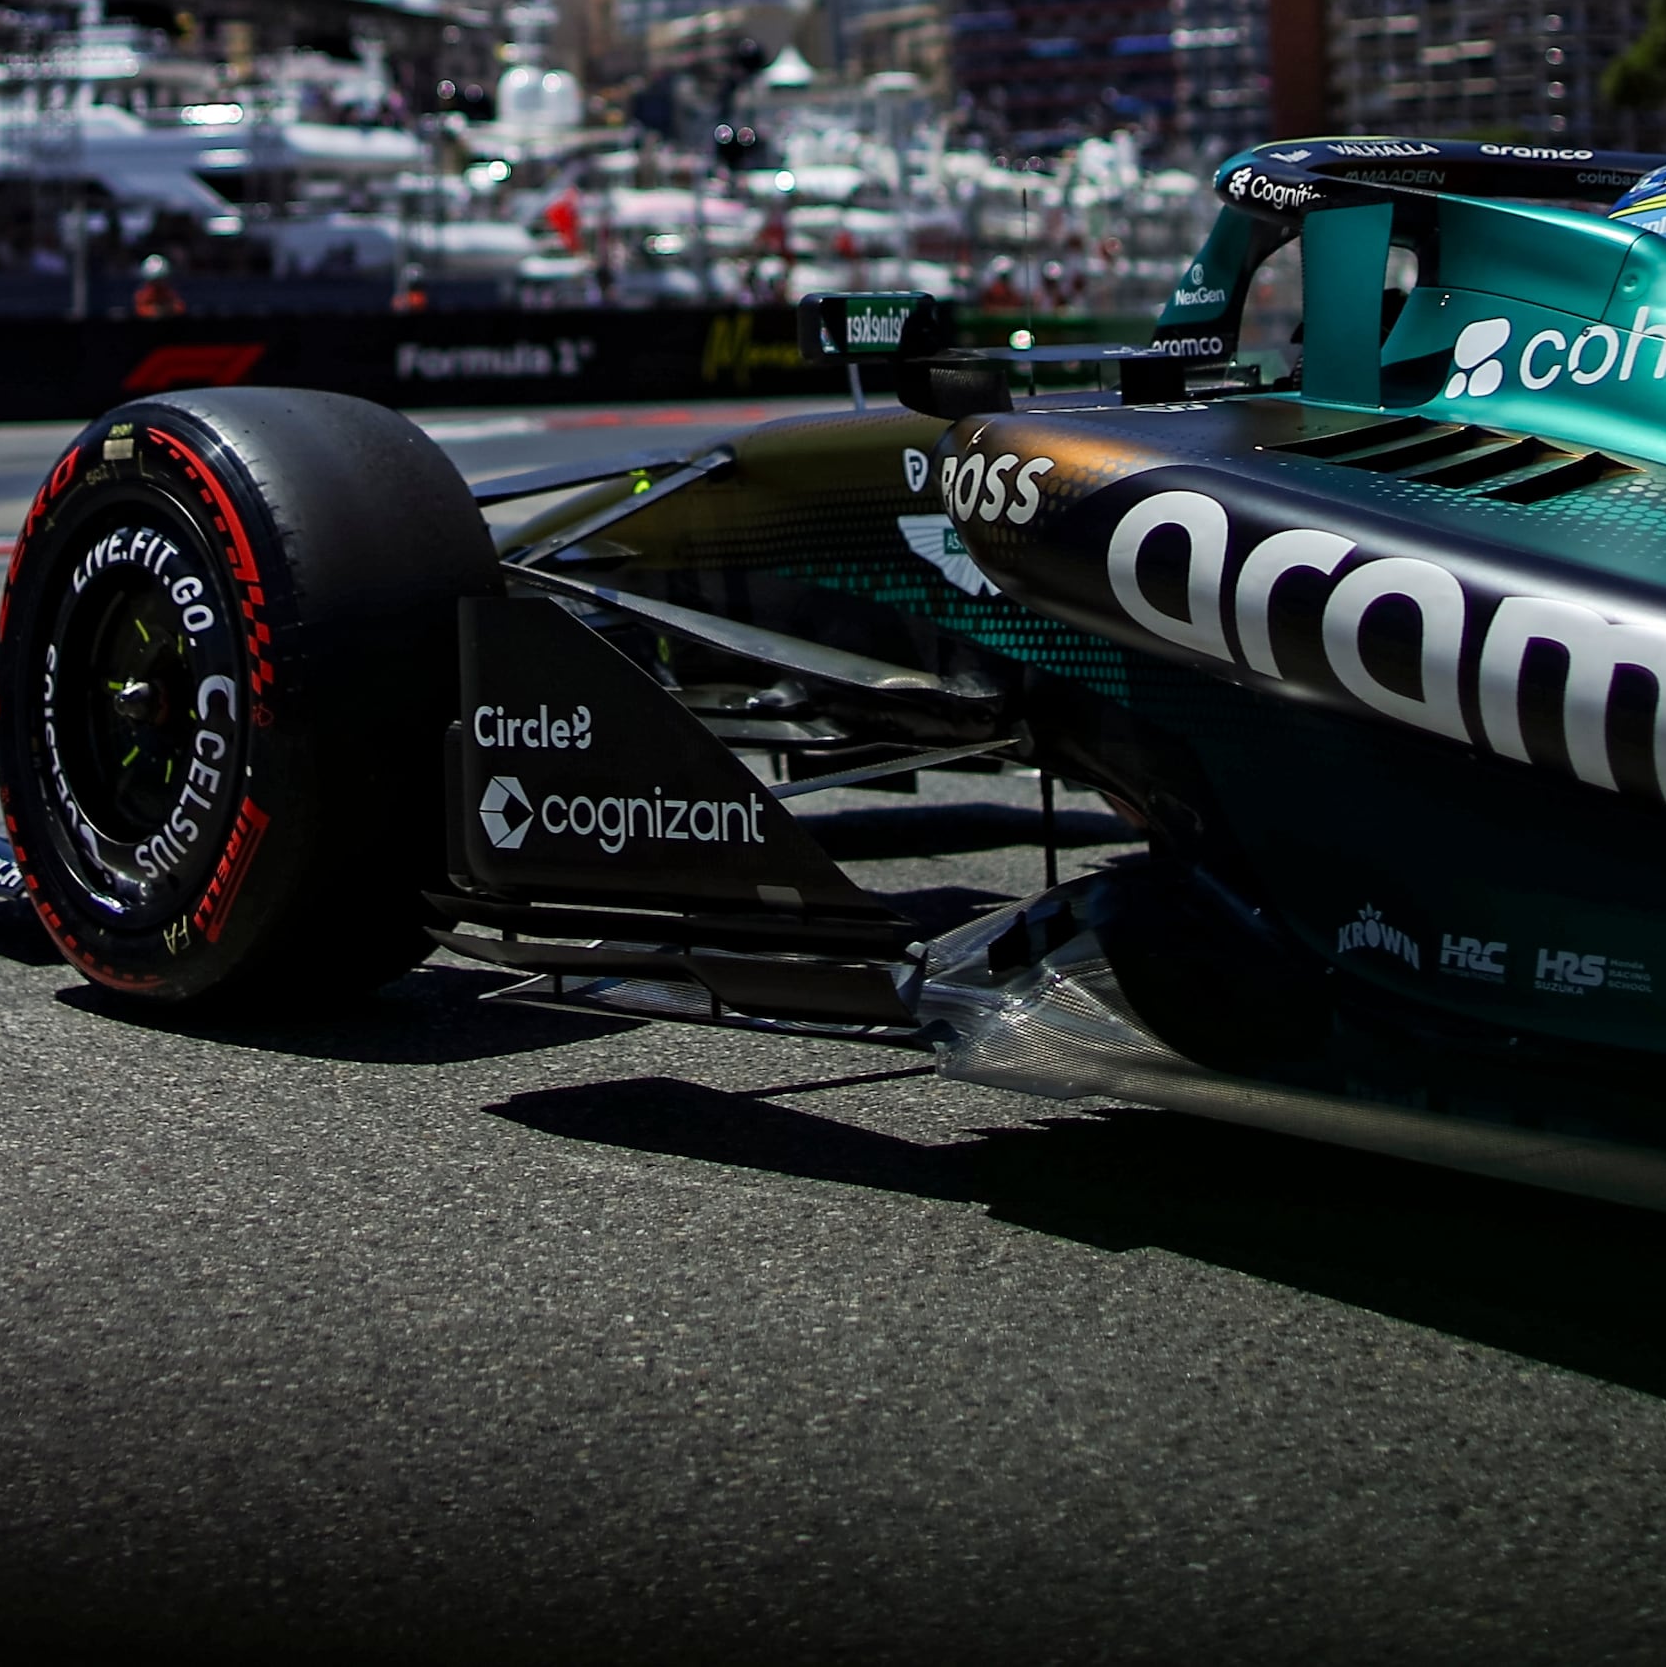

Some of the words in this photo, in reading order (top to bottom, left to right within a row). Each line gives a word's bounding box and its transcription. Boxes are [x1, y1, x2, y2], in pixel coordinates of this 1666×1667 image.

[1326, 142, 1441, 159] VALHALLA
[1479, 142, 1595, 162] aramco
[1174, 285, 1226, 307] NexGen
[396, 342, 550, 381] Formula
[941, 452, 1055, 525] BOSS
[133, 728, 227, 879] CELSIUS
[541, 786, 765, 854] cognizant
[1337, 918, 1421, 972] KROWN
[1438, 933, 1509, 975] HRC
[1535, 947, 1608, 987] HRS
[1534, 980, 1585, 996] SUZUKA
